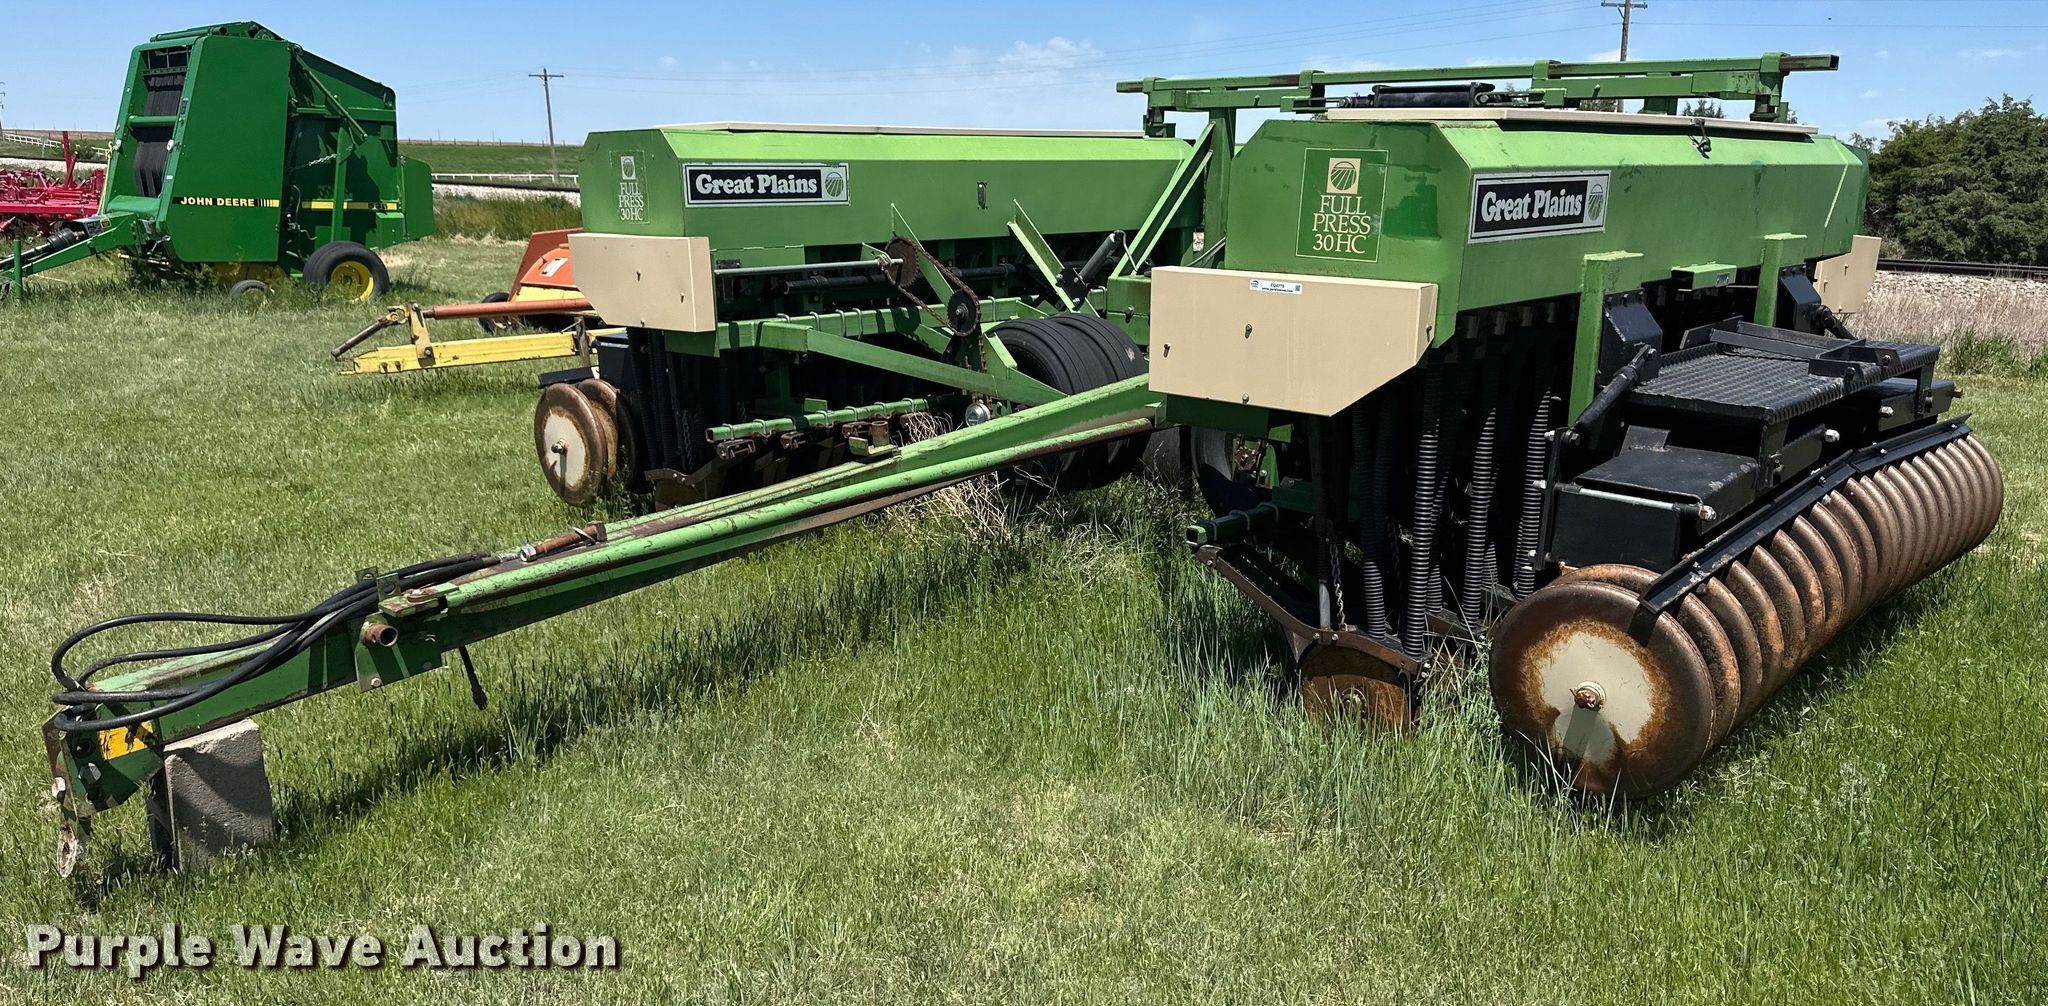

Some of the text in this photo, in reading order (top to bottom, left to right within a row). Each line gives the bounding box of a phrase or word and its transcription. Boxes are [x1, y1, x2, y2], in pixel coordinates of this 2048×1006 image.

[619, 182, 641, 195] FULL
[695, 173, 818, 195] Great Plains
[180, 197, 255, 207] JOHN DEERE
[618, 194, 645, 208] PRESS
[1319, 194, 1367, 215] FULL
[1481, 188, 1583, 222] Great Plains
[620, 207, 644, 221] 30HC
[1312, 212, 1371, 235] PRESS
[1312, 233, 1367, 254] 30HC
